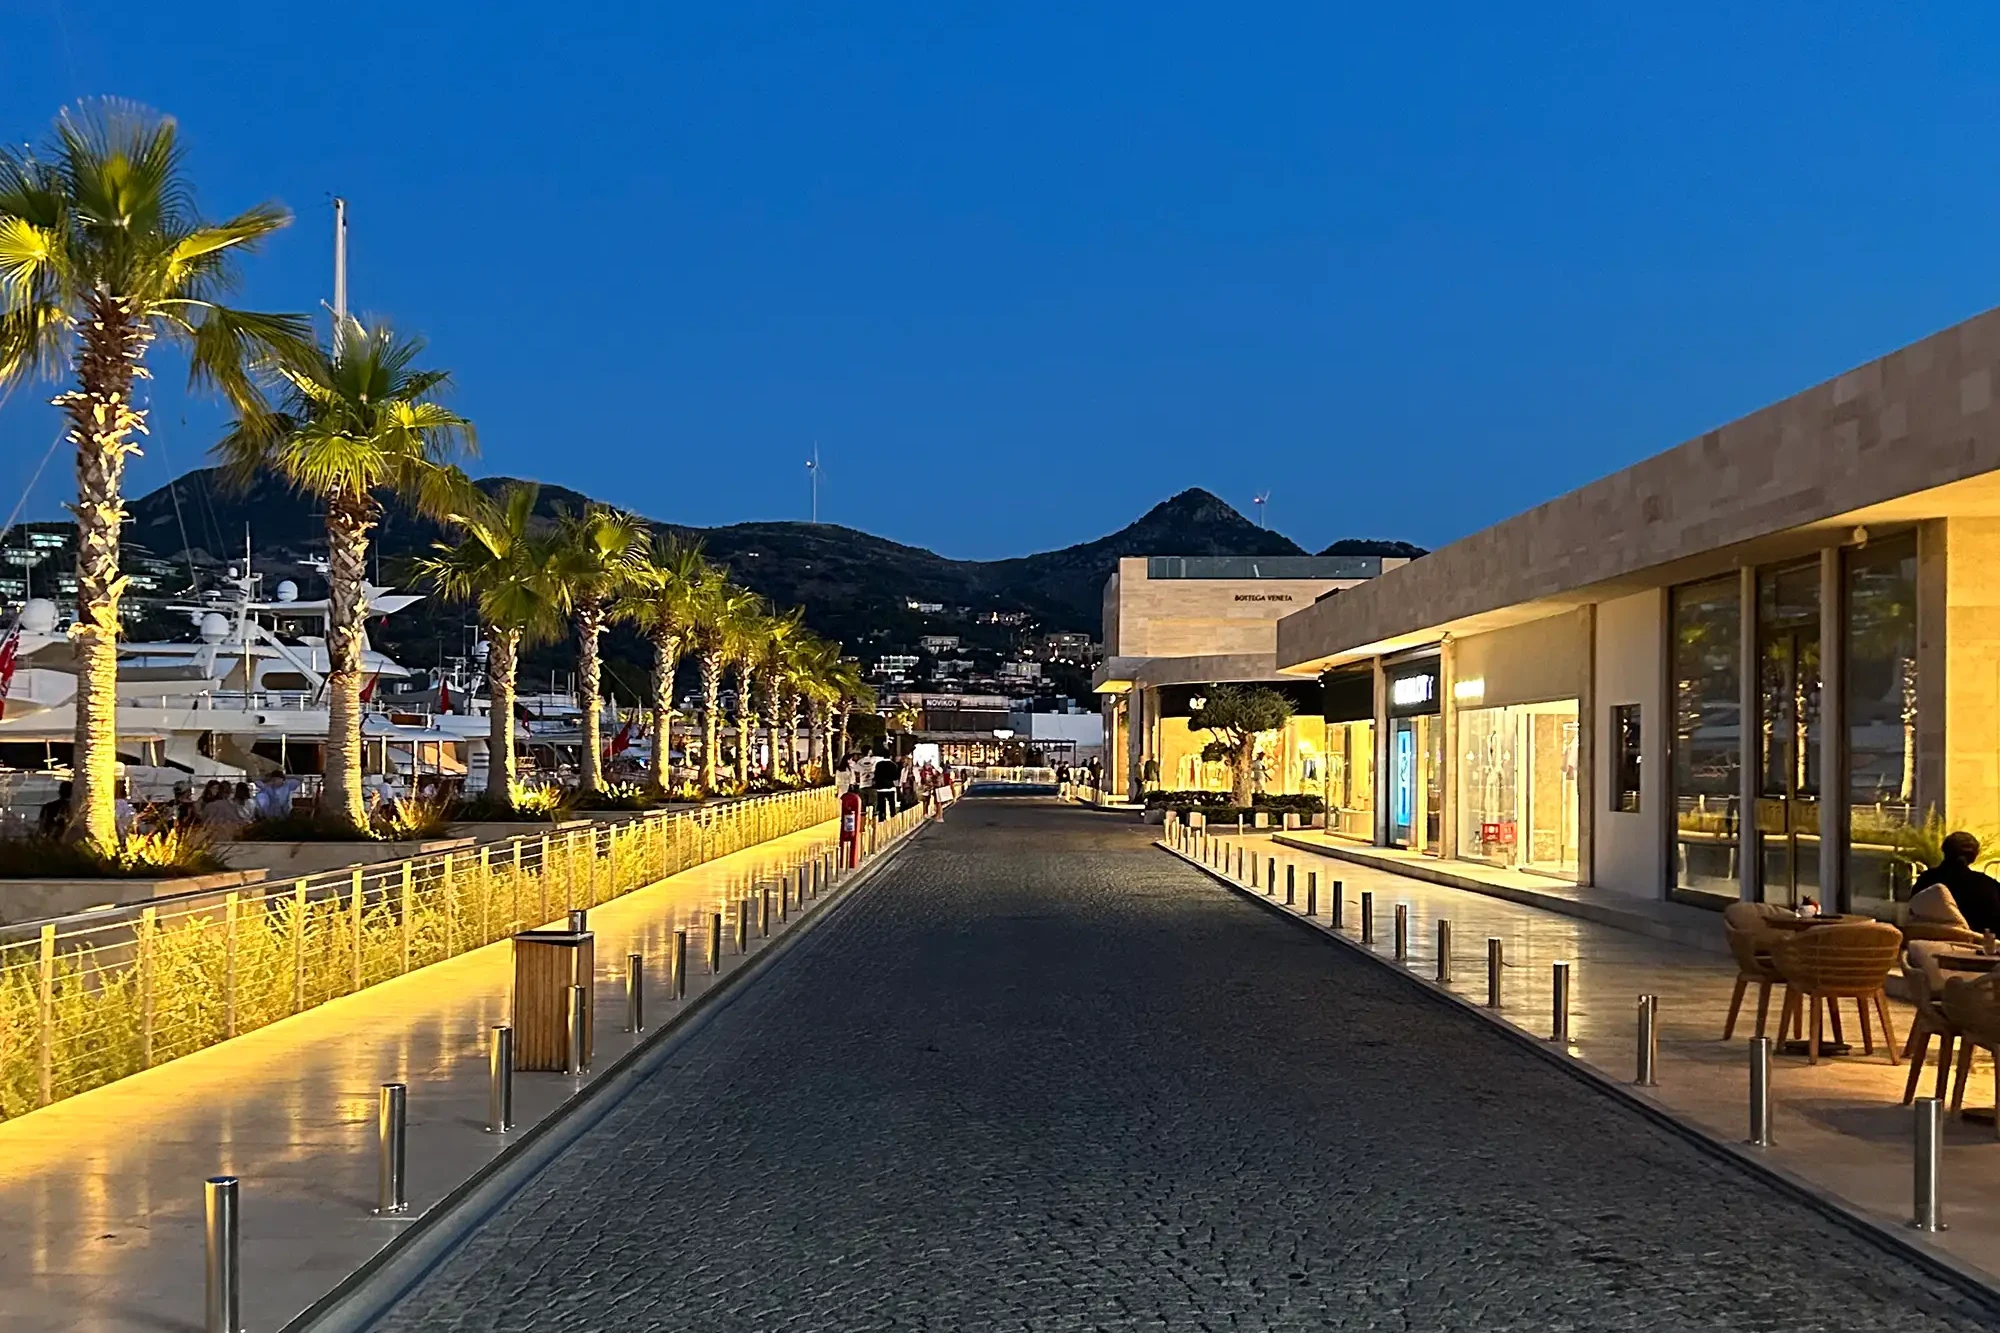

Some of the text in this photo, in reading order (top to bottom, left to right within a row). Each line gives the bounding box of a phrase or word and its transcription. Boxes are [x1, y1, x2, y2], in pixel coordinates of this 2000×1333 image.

[1234, 594, 1293, 602] BOTTEGA VENETA
[926, 699, 958, 707] NOVIKOV
